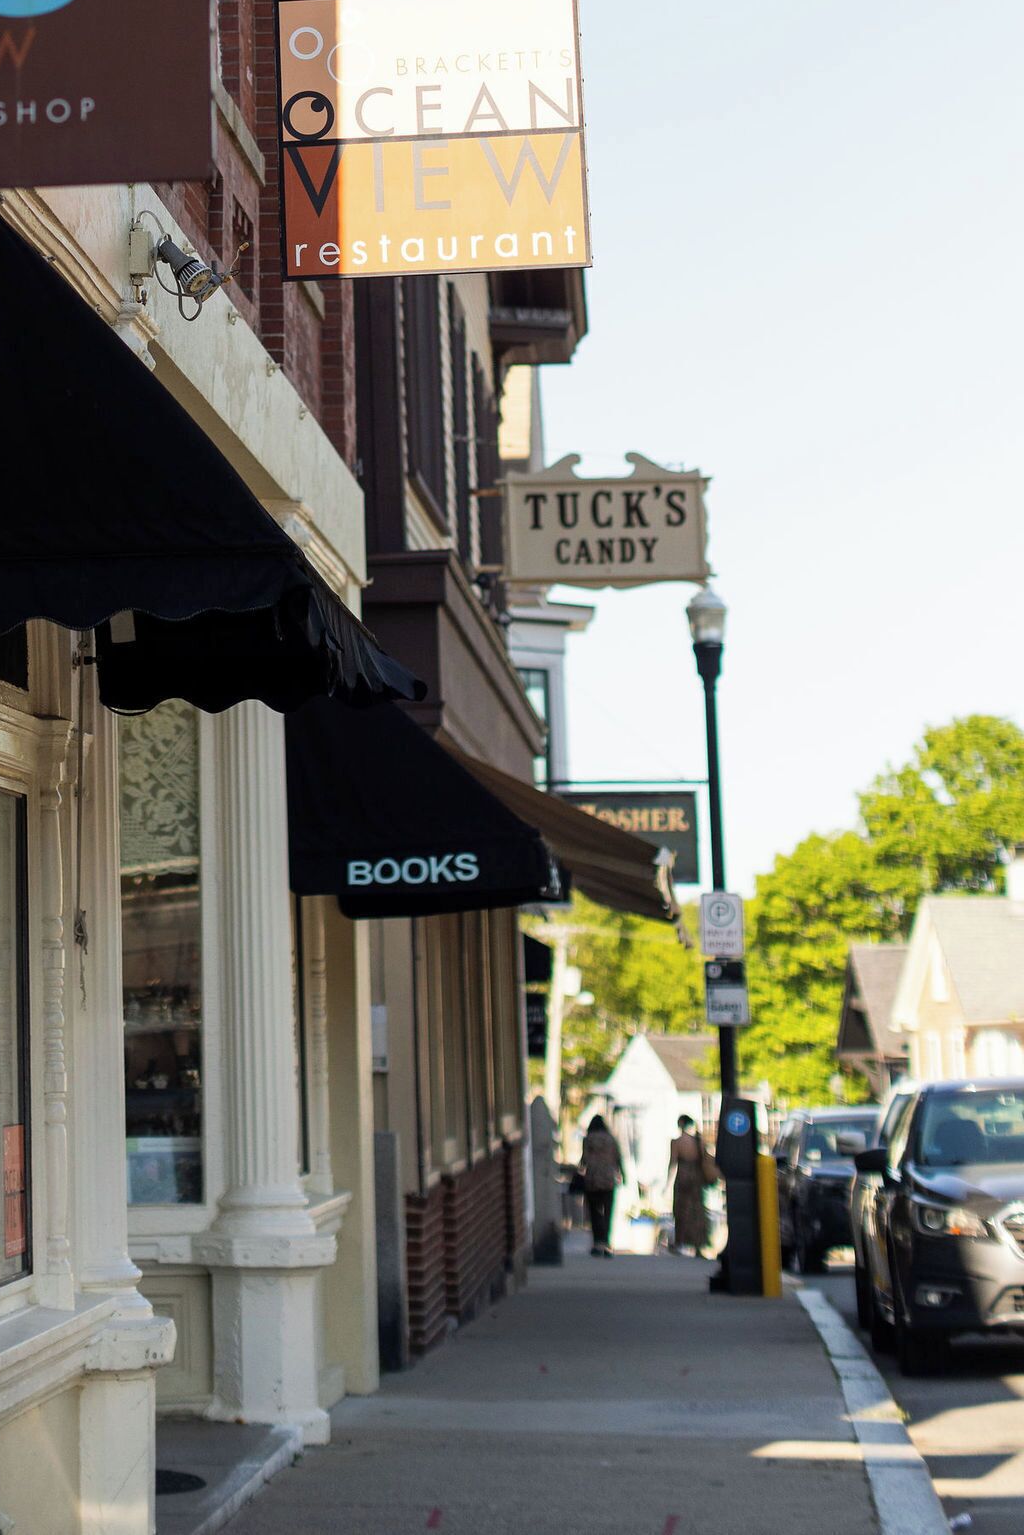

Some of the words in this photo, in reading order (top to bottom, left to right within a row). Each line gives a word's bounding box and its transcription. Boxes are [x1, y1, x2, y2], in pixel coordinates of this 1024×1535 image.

[396, 48, 574, 76] BRACKETT'S
[283, 78, 575, 141] OCEAN
[287, 132, 576, 219] VIEW
[295, 225, 577, 267] restaurant
[525, 484, 687, 530] TUCK'S
[555, 537, 659, 565] CANDY
[577, 804, 690, 832] OSHER
[347, 853, 479, 886] BOOKS
